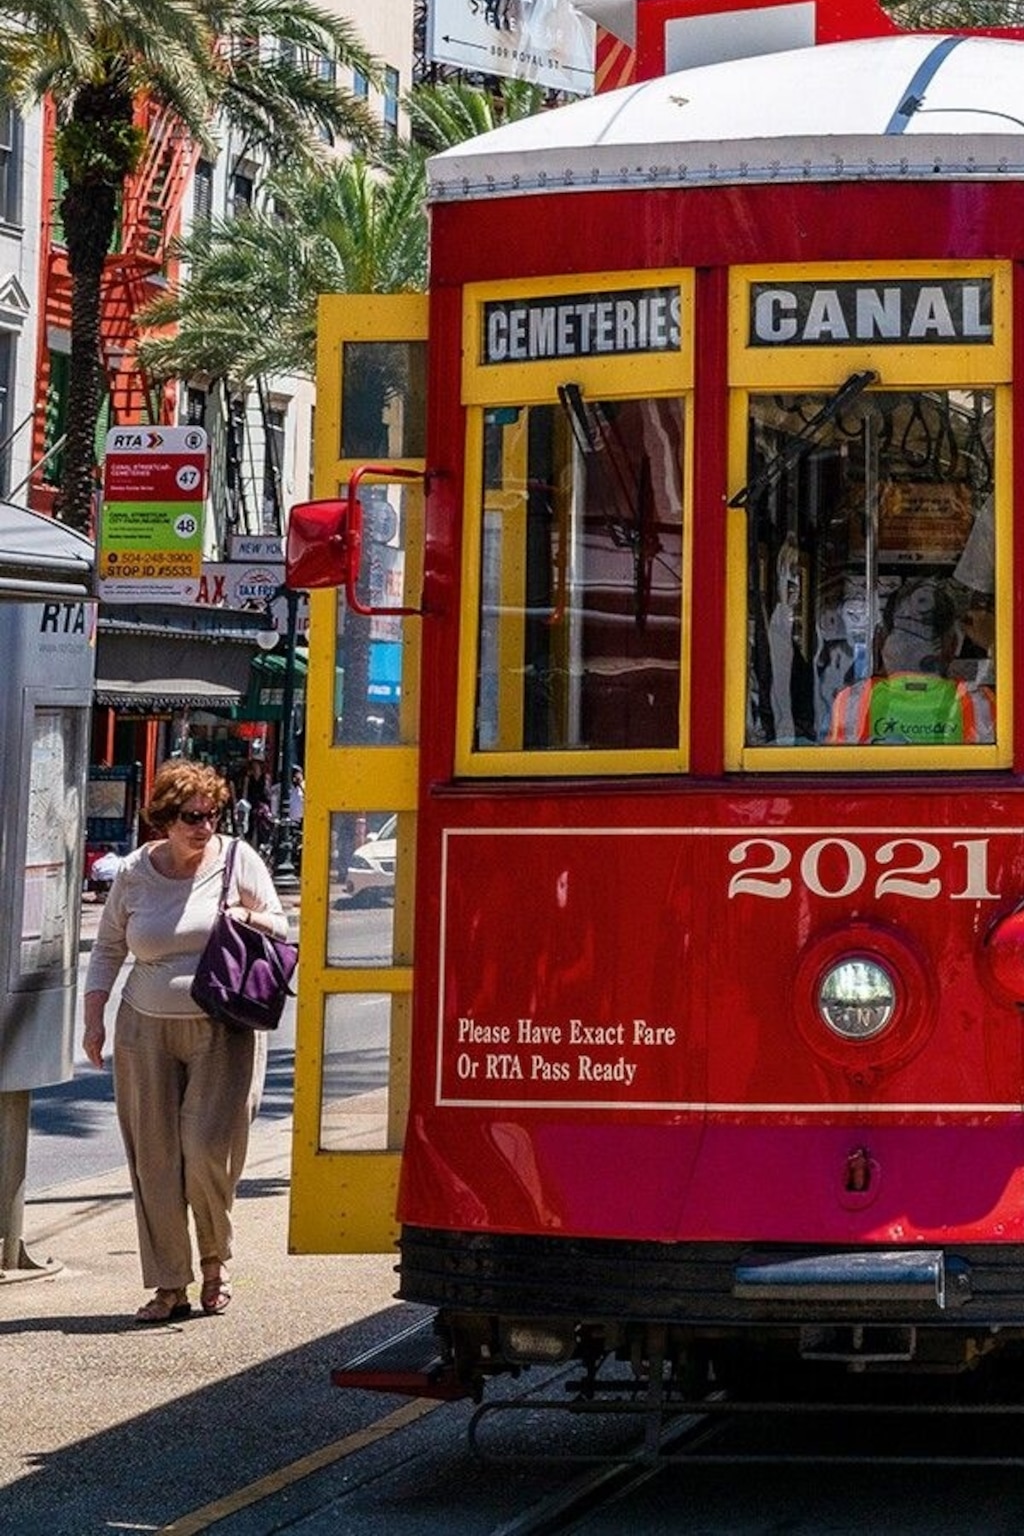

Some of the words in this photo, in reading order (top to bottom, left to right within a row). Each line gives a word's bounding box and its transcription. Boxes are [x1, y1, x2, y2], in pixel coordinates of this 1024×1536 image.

[755, 285, 993, 342] CANAL
[488, 296, 682, 361] CEMETERIES
[114, 435, 142, 446] RTA
[179, 472, 197, 485] 47
[177, 519, 195, 533] 48
[239, 542, 261, 554] NEW
[107, 565, 139, 577] STOP
[143, 565, 155, 576] ID
[159, 565, 192, 576] #5533
[239, 585, 256, 596] TAX
[40, 602, 84, 634] RTA
[728, 838, 1002, 899] 2021
[458, 1018, 510, 1044] Please
[517, 1019, 562, 1045] Have
[569, 1019, 625, 1045] Exact
[632, 1019, 677, 1046] Fare
[457, 1053, 479, 1080] Or
[485, 1054, 524, 1080] RTA
[531, 1055, 570, 1081] Pass
[578, 1055, 638, 1086] Ready
